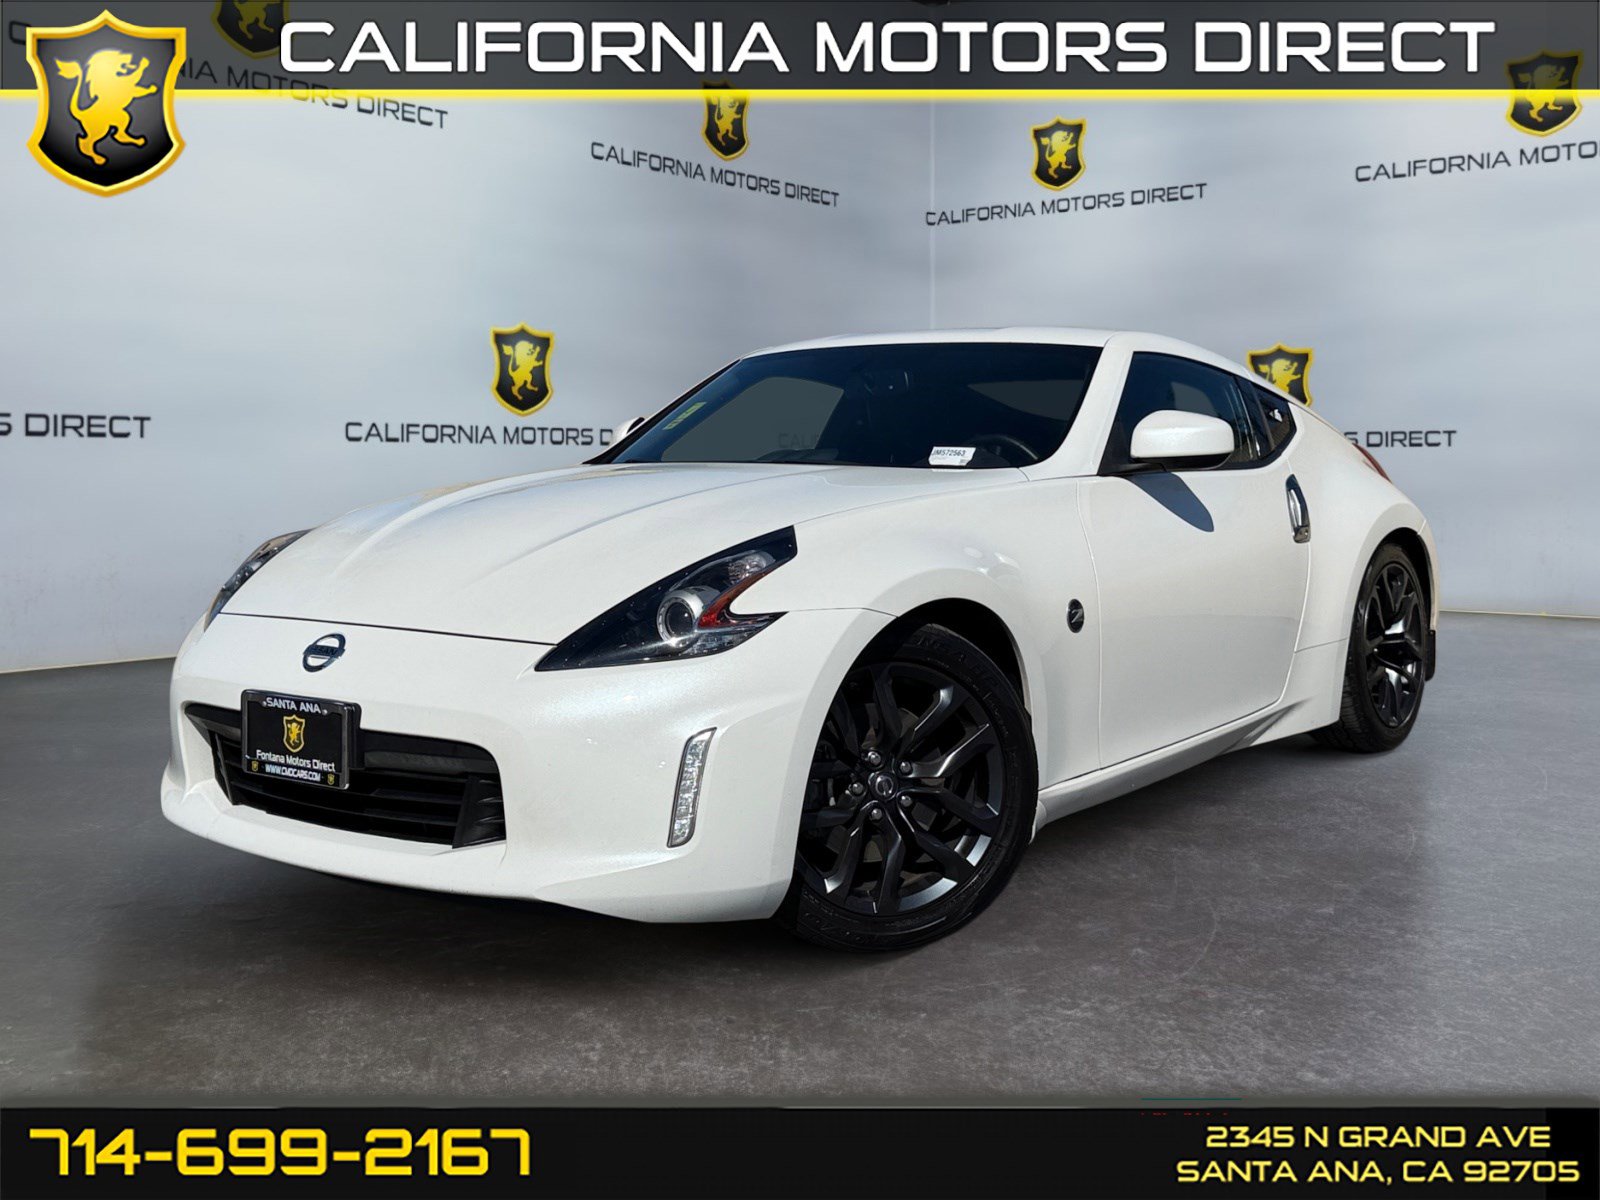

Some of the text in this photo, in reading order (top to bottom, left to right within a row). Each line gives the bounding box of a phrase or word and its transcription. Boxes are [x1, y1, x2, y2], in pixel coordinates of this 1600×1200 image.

[356, 94, 449, 129] DIRECT
[591, 141, 840, 208] CALIFORNIA MOTORS DIRECT
[1355, 140, 1600, 183] CALIFORNIA MOTO
[925, 182, 1208, 226] CALIFORNIA MOTORS DIRECT
[24, 413, 152, 438] DIRECT
[345, 421, 497, 445] CALIFORNIA
[502, 426, 594, 447] MOTORS
[1366, 430, 1457, 448] DIRECT
[266, 697, 322, 714] SANTA ANA
[256, 750, 336, 773] Fontana Motors Direct
